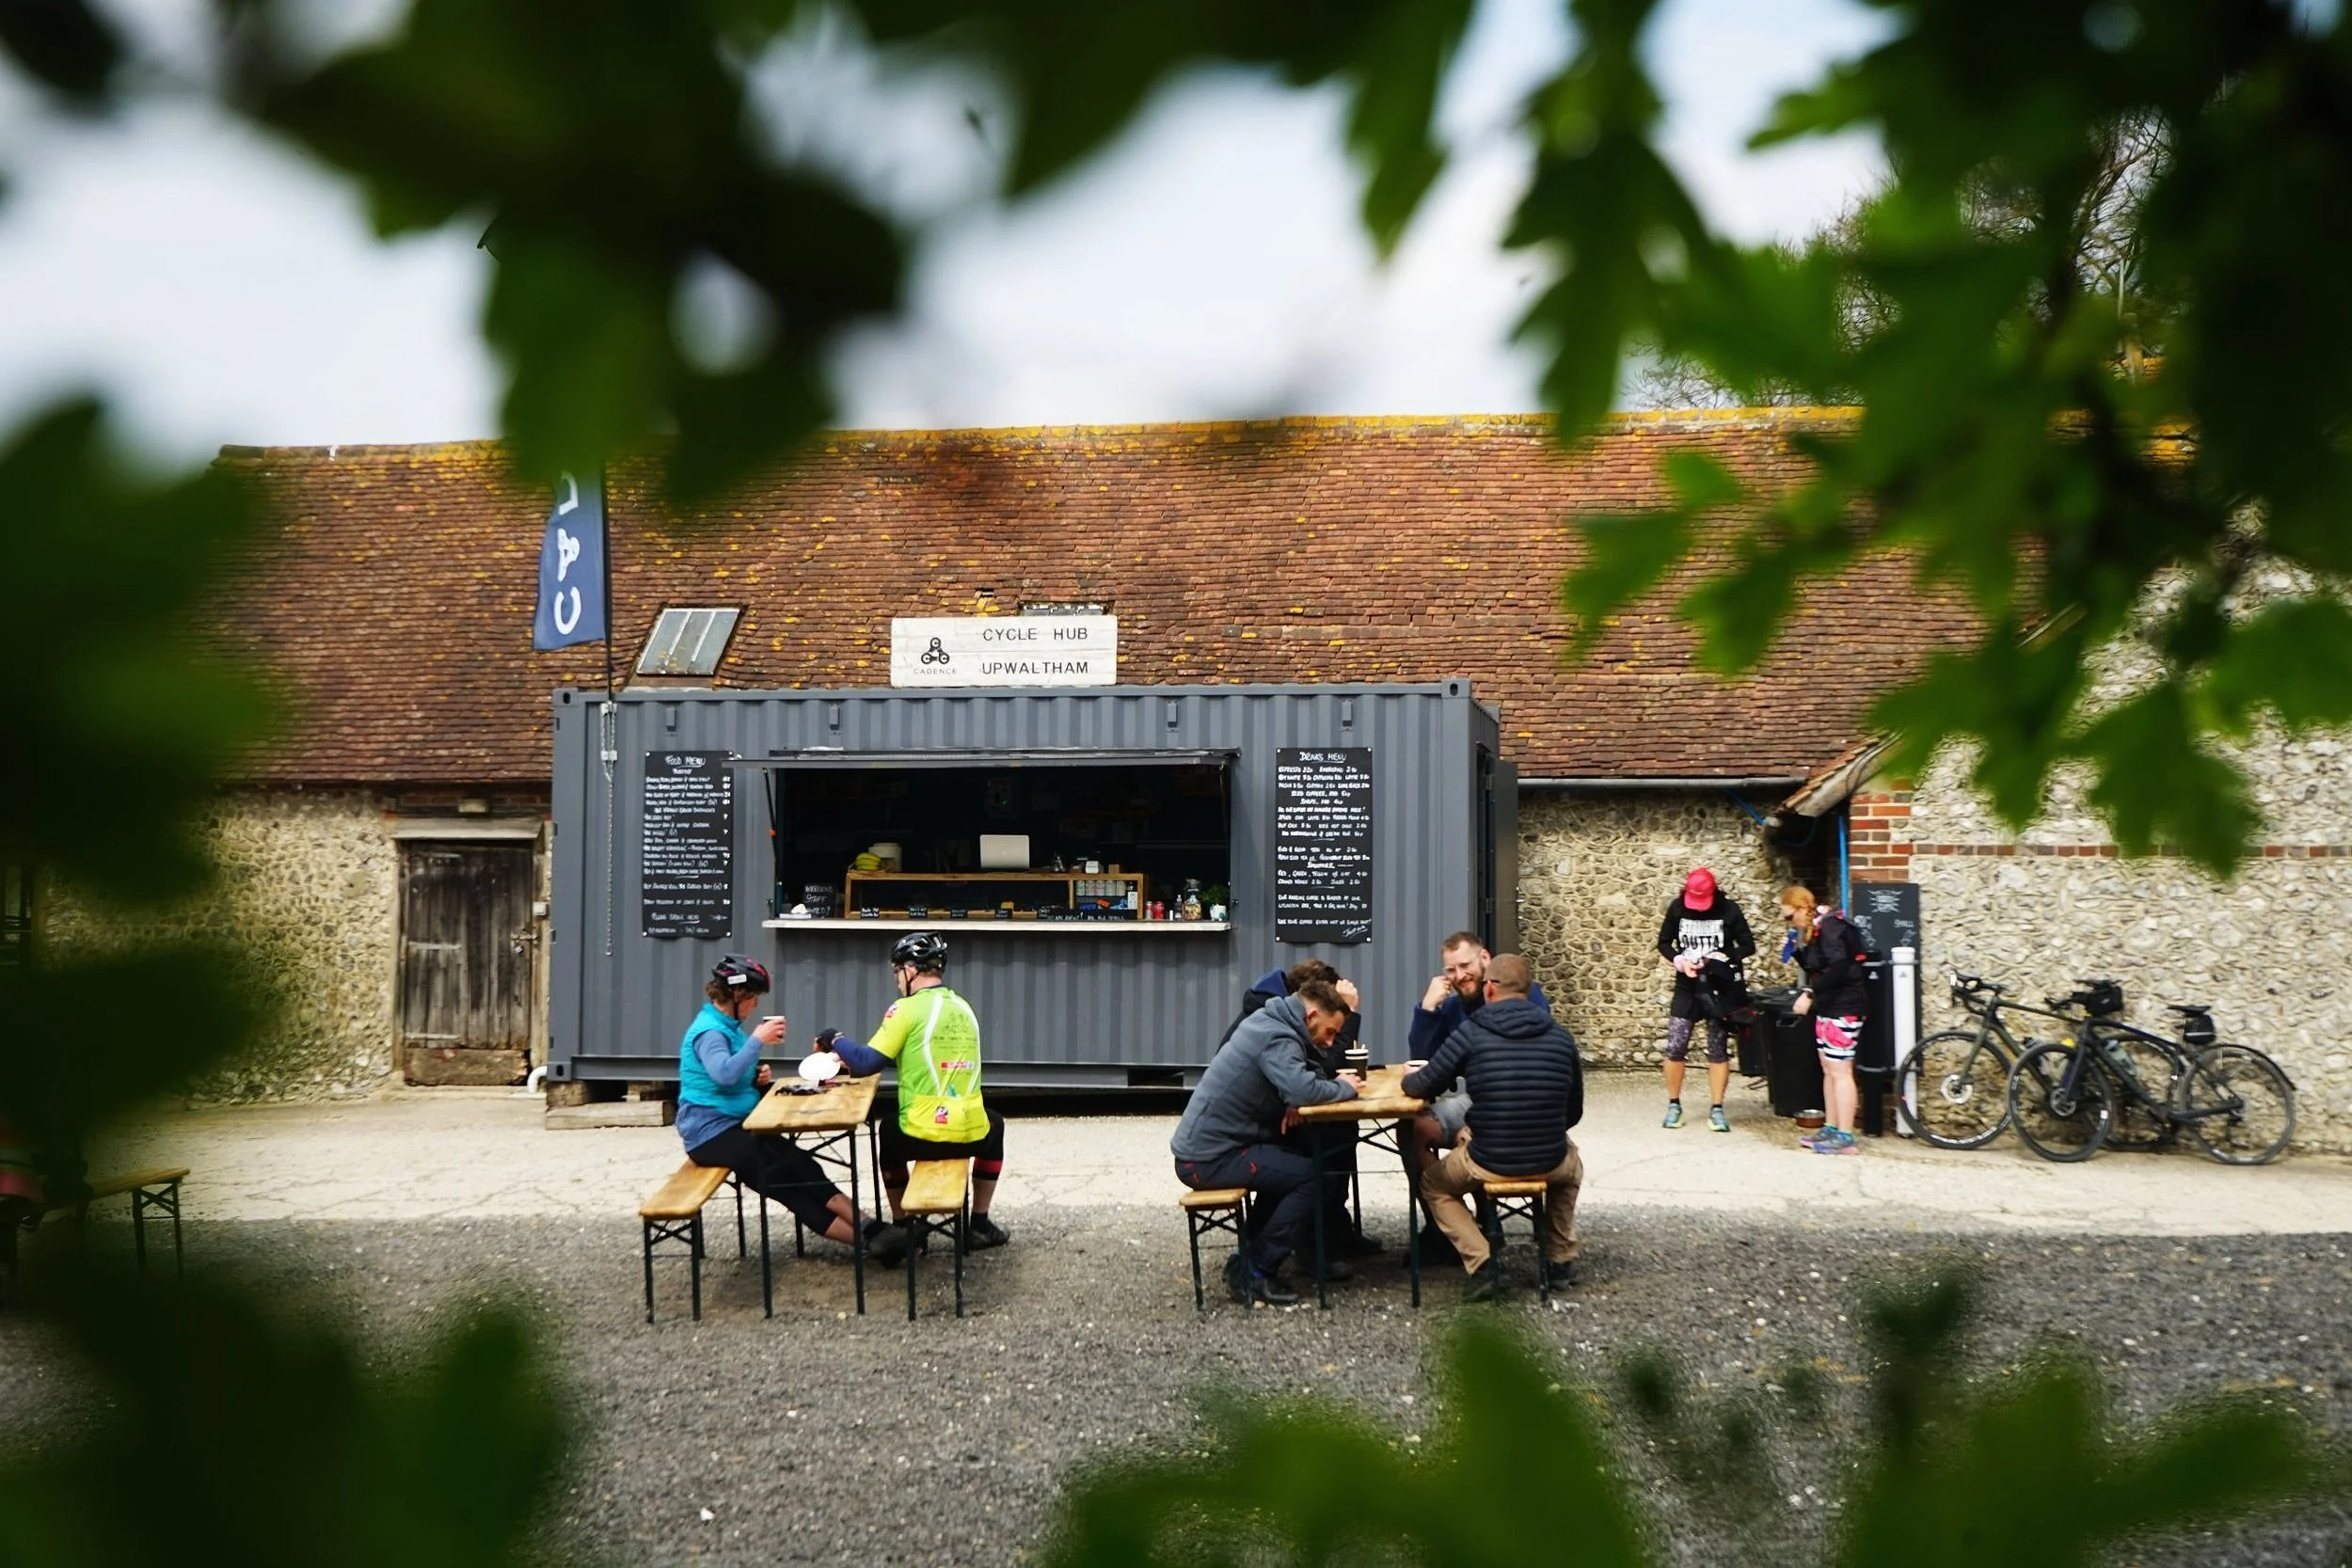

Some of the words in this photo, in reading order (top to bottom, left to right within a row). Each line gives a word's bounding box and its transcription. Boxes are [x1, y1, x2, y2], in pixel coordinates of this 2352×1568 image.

[983, 627, 1037, 641] CYCLE
[1054, 627, 1088, 640] HUB
[982, 661, 1089, 674] UPWALTHAM
[1299, 752, 1324, 761] DRINKS
[1682, 935, 1719, 949] OUTTA
